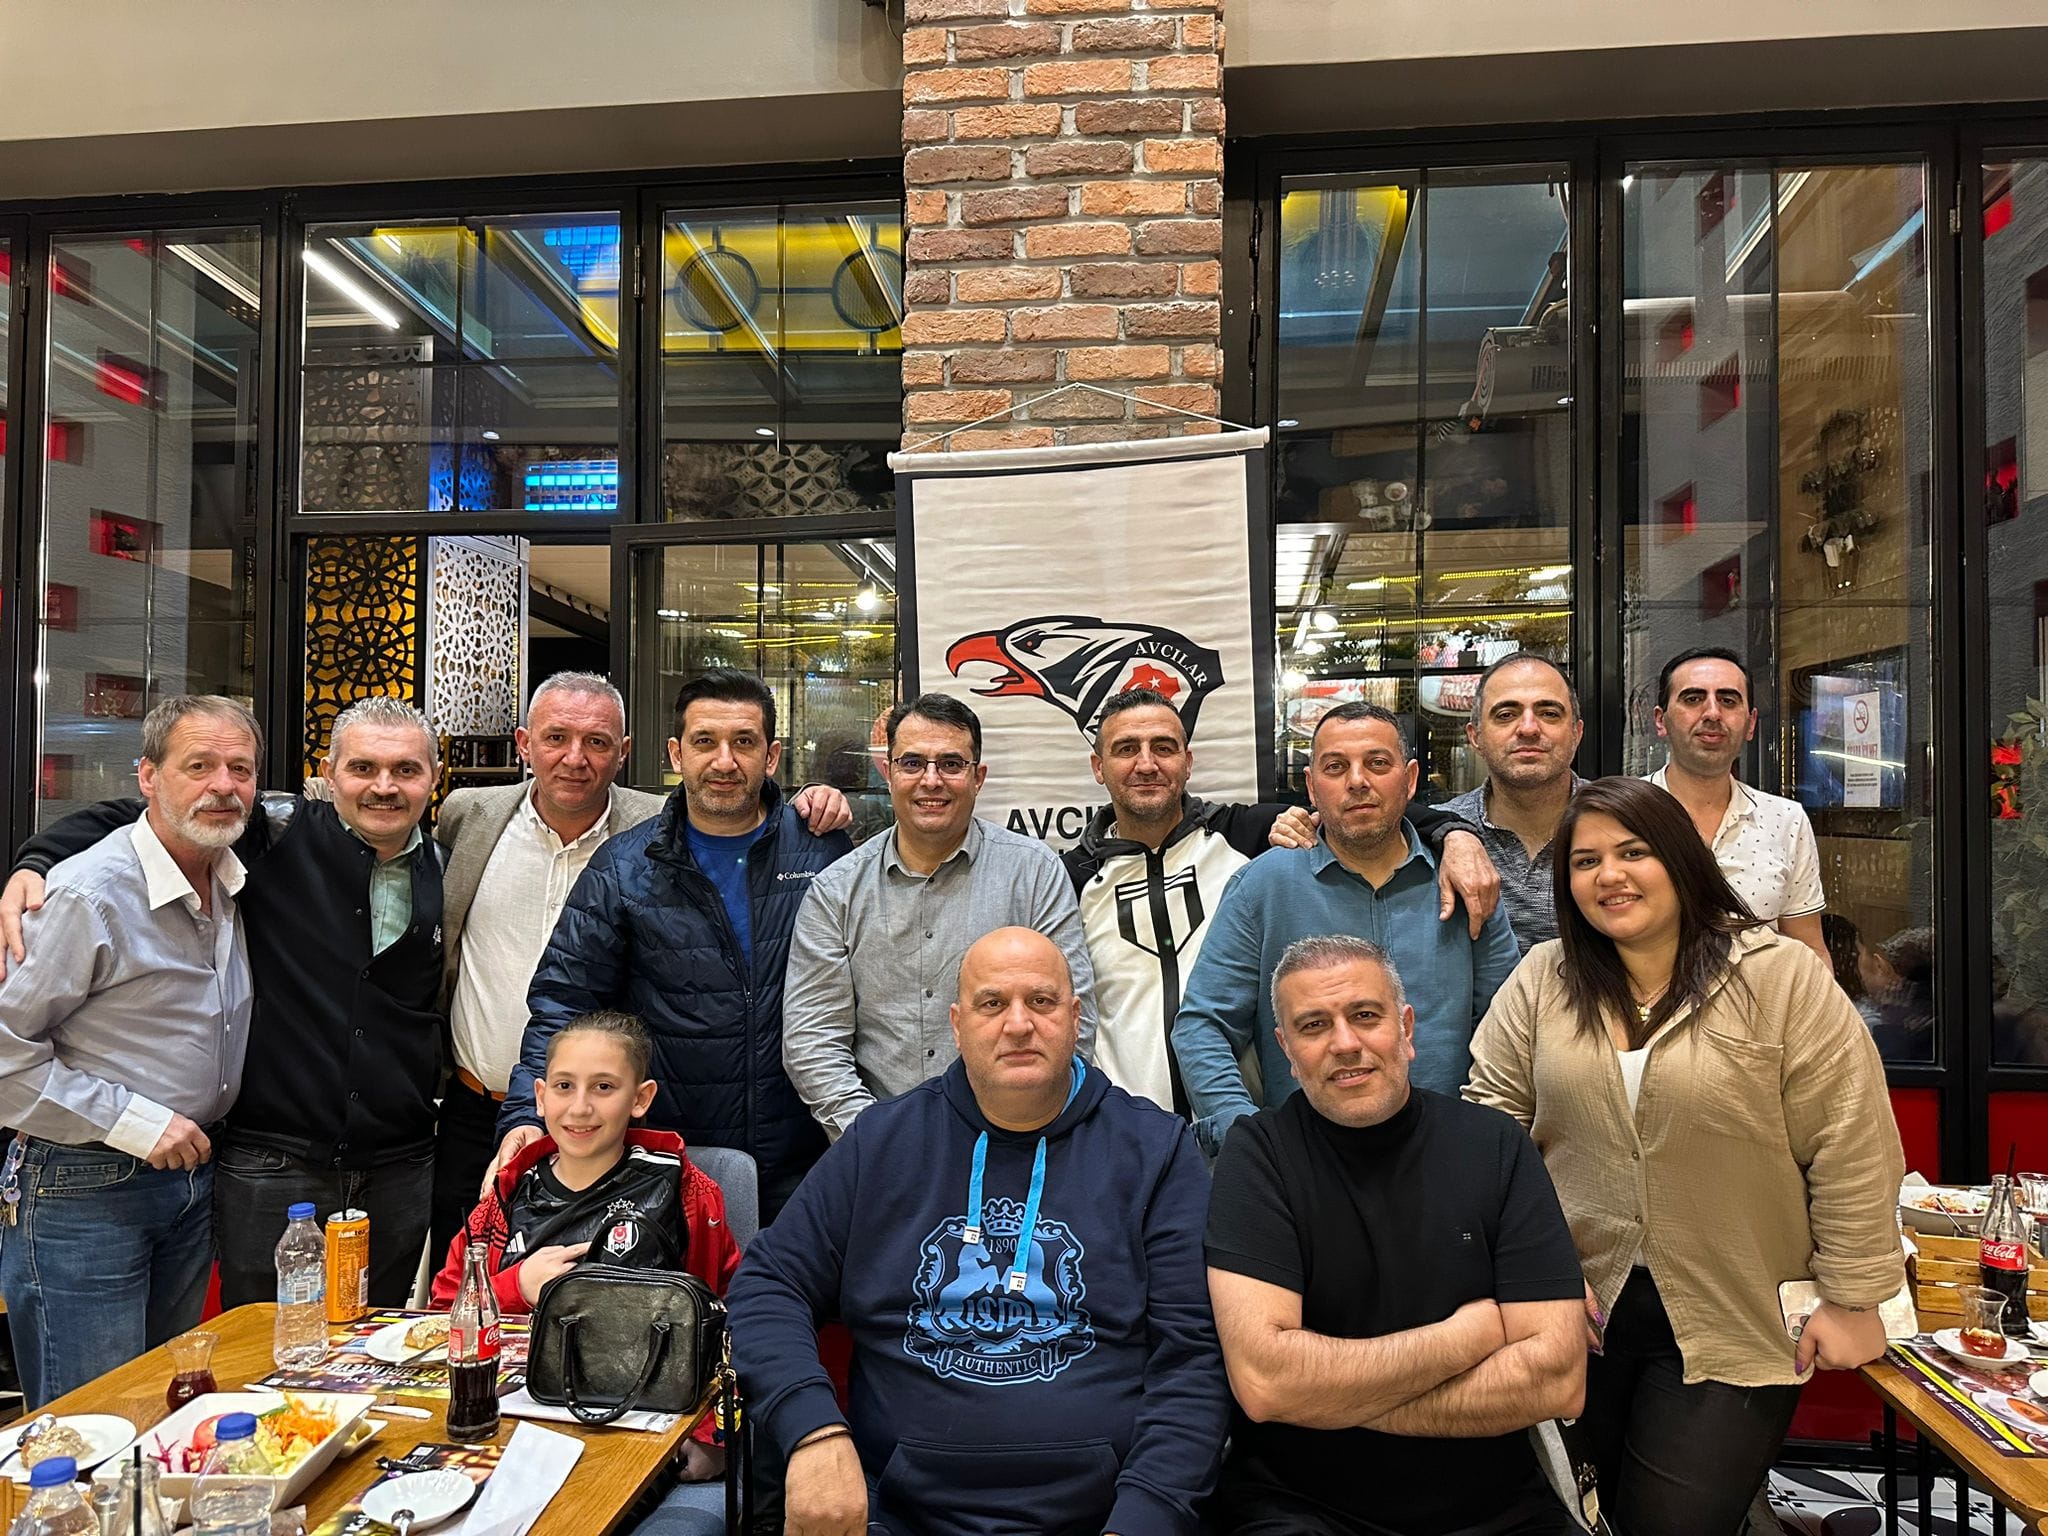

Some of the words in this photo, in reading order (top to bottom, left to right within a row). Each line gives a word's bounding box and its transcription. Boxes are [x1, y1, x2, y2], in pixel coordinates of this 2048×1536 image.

[1135, 641, 1208, 688] AVCILAR
[784, 870, 816, 880] Columbia
[988, 1237, 1017, 1254] 1890
[954, 1355, 1039, 1375] AUTHENTIC
